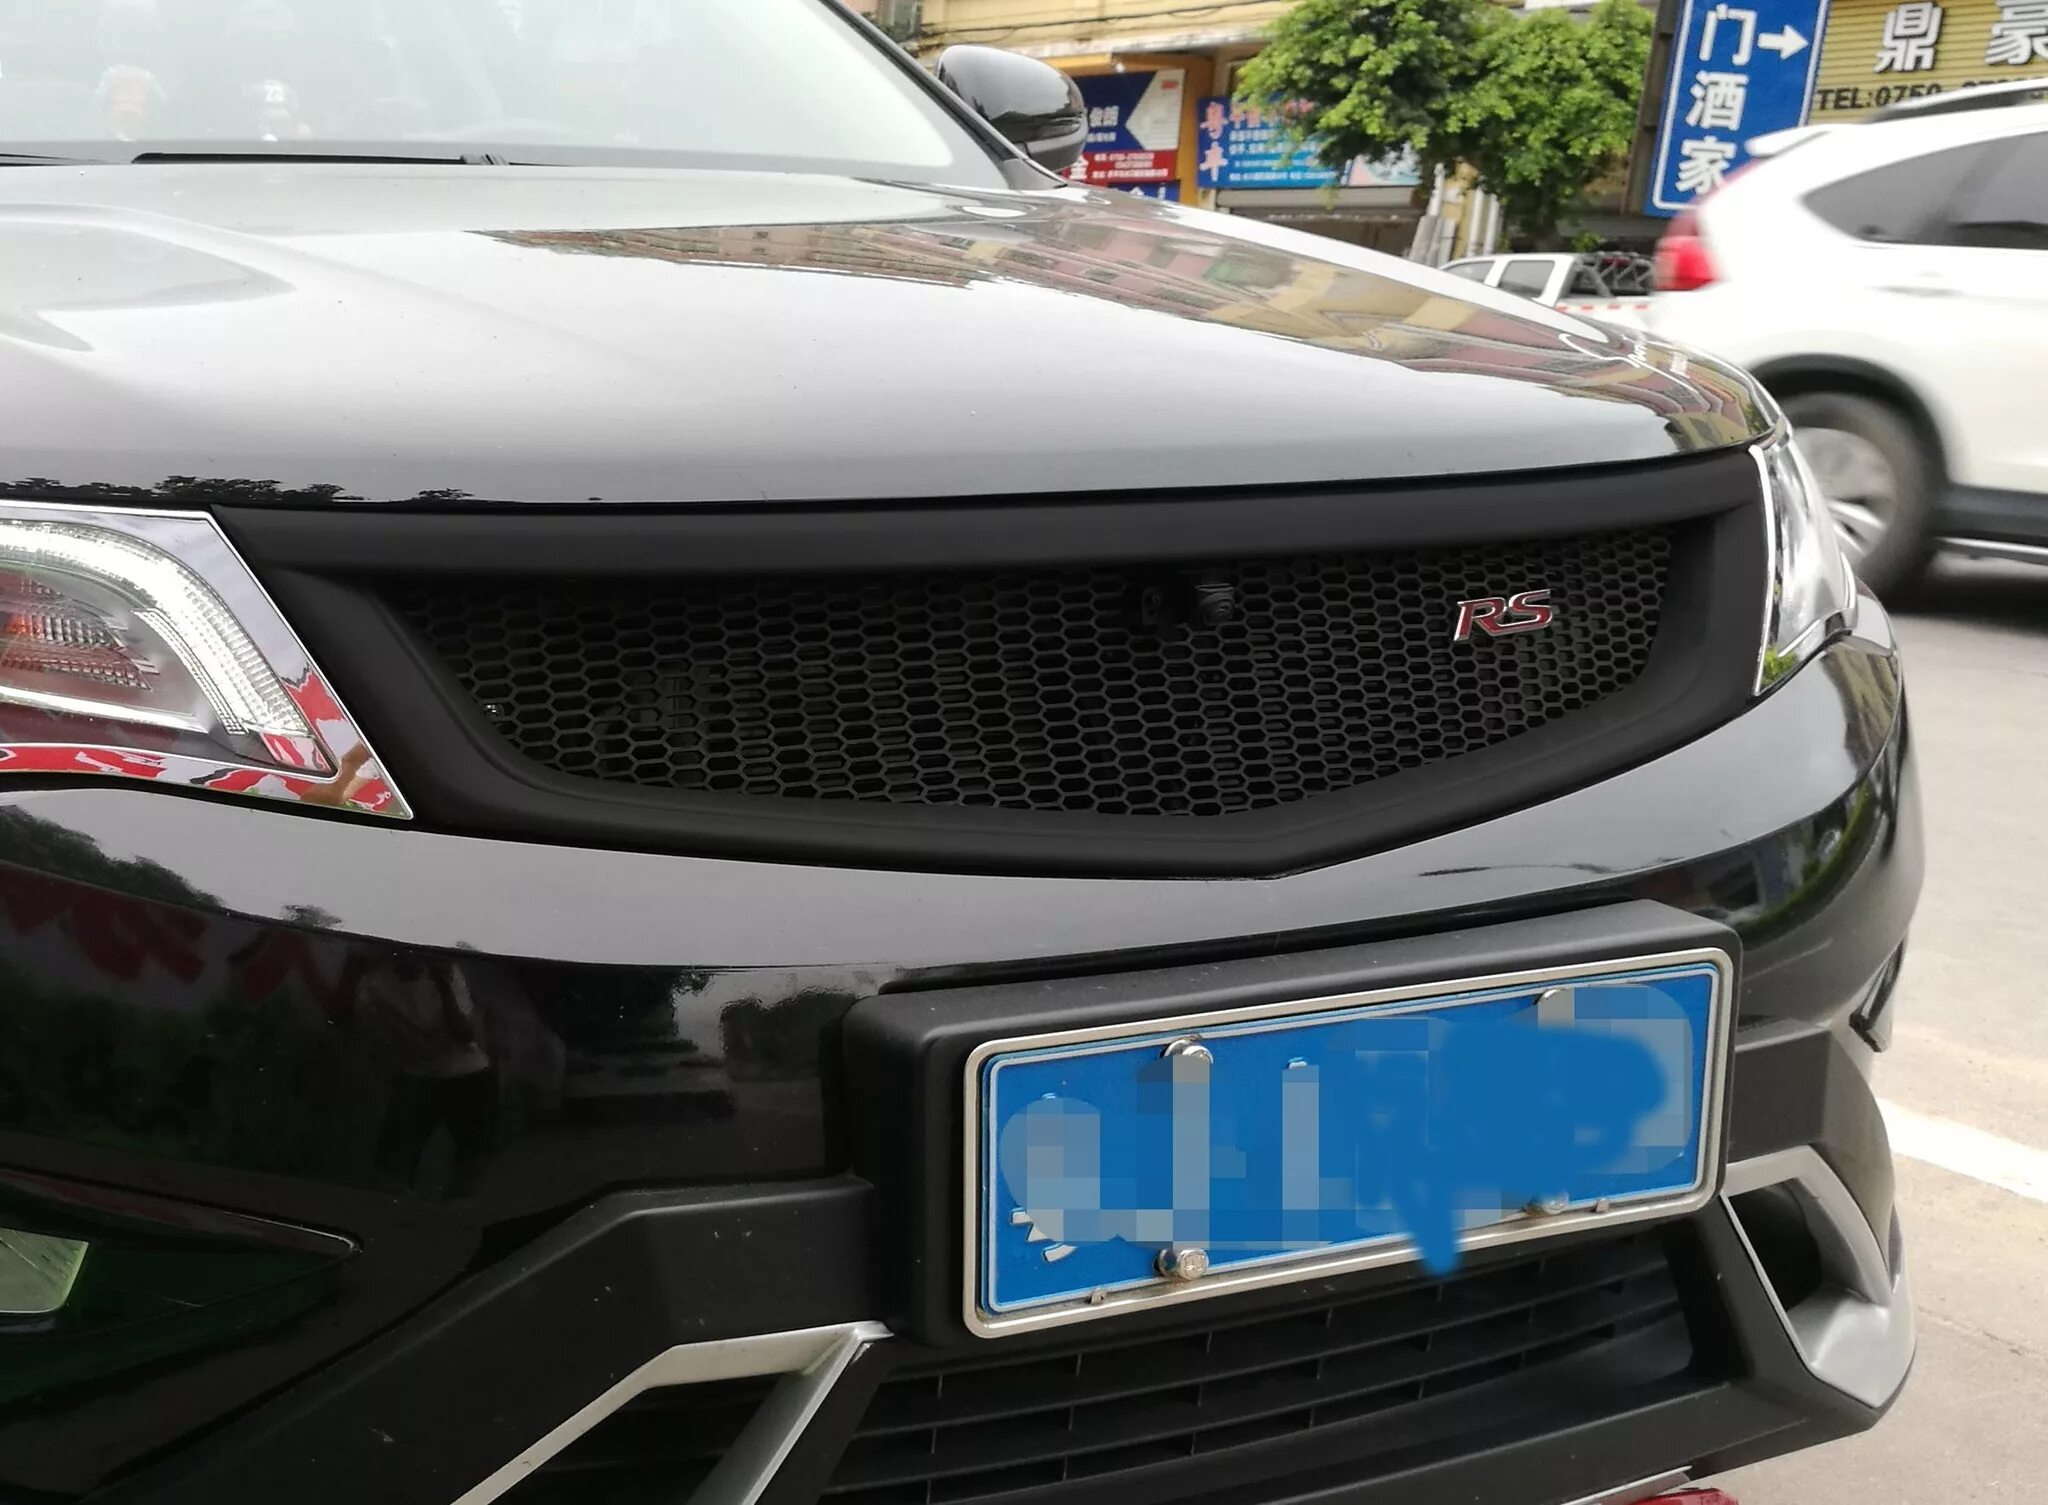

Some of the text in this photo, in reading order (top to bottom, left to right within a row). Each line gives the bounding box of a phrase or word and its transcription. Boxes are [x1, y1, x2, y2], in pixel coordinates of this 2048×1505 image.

[1674, 3, 1758, 195] 门酒家
[1453, 588, 1553, 641] RS
